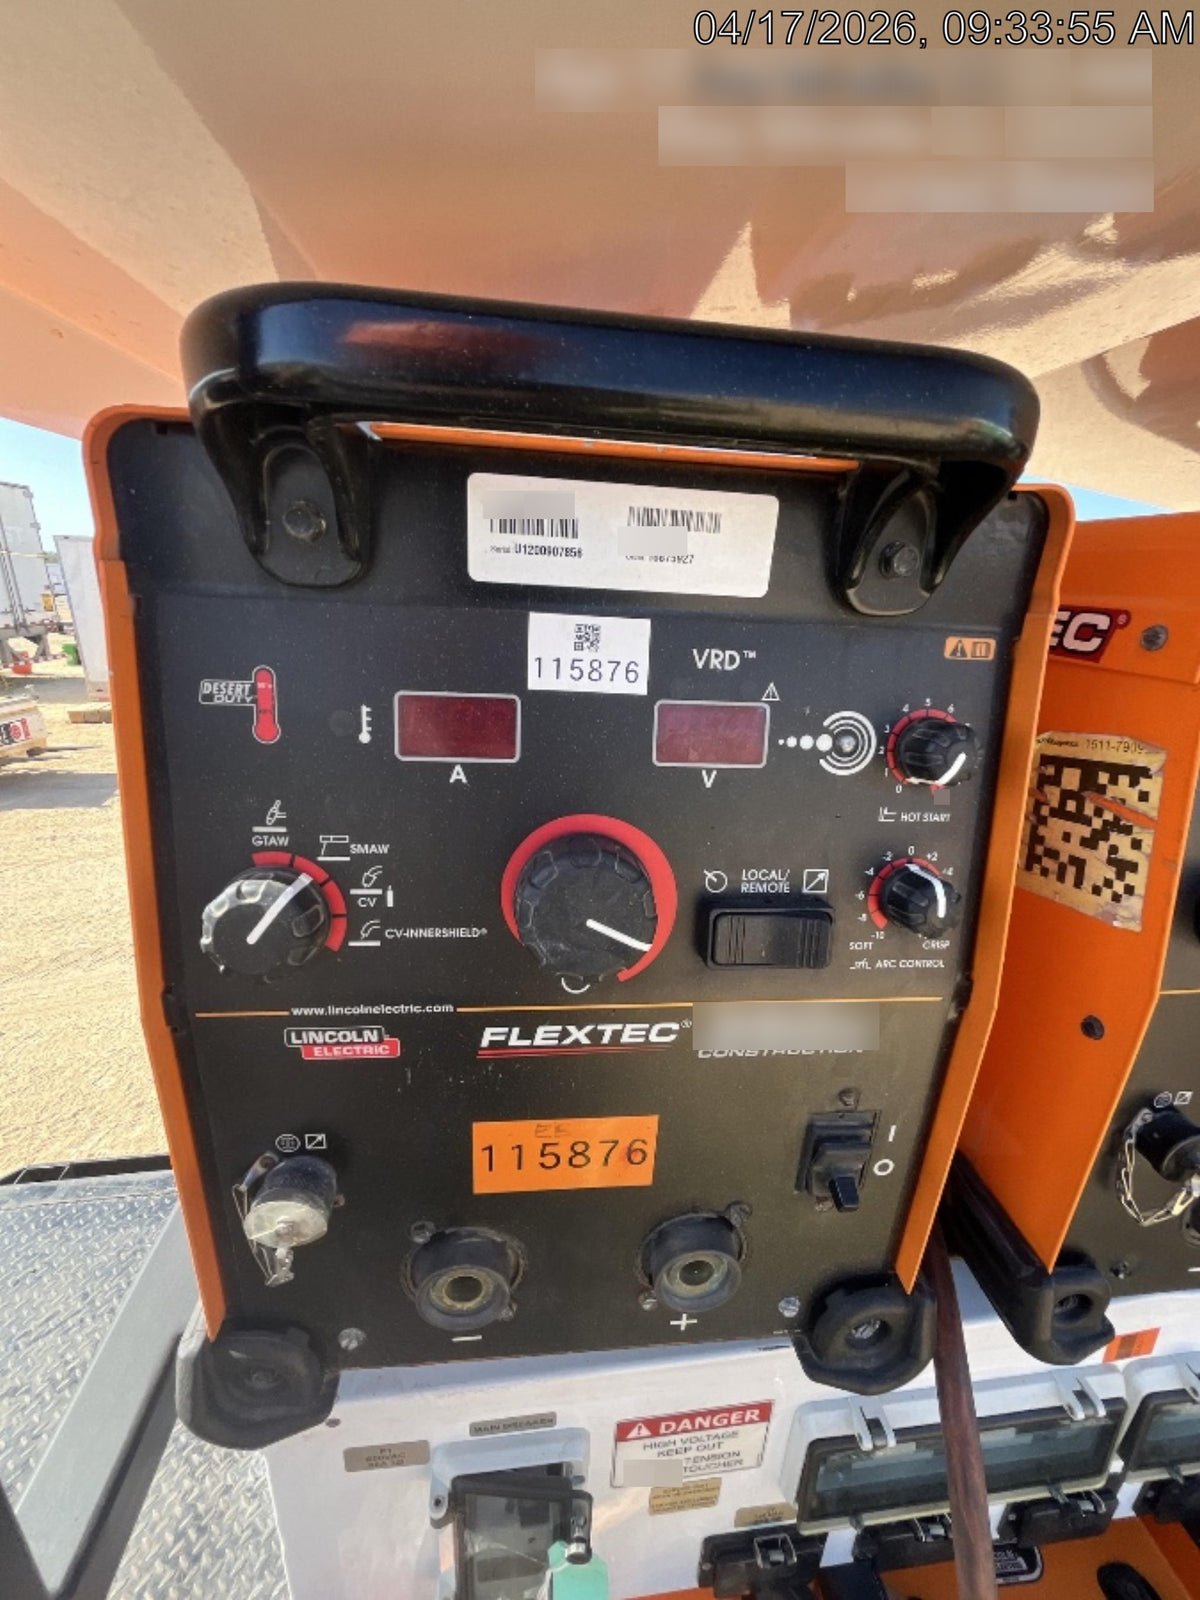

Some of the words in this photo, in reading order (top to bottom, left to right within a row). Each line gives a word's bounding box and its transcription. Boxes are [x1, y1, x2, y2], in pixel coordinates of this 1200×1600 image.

[534, 656, 640, 684] 115876
[202, 682, 252, 697] DESERT
[213, 694, 254, 703] DUTY
[449, 764, 468, 784] A
[701, 769, 717, 788] V
[900, 812, 920, 822] HOT
[922, 812, 951, 822] START
[252, 835, 289, 847] GTAW
[350, 843, 390, 854] SMAW
[907, 845, 915, 855] 0
[741, 868, 791, 881] LOCAL/
[740, 881, 791, 893] REMOTE
[358, 896, 376, 908] CV
[848, 941, 874, 951] SOFT
[922, 940, 951, 950] CRISP
[875, 959, 897, 968] ARC
[898, 959, 945, 968] CONTROL
[290, 1003, 455, 1016] www.lincolnelectric.com
[290, 1029, 380, 1044] LINCOLN
[313, 1044, 390, 1057] ELECTRIC
[481, 1138, 649, 1173] 115876
[659, 1409, 761, 1435] DANGER
[642, 1438, 677, 1451] HIGH
[680, 1430, 740, 1446] VOLTAGE
[656, 1446, 693, 1458] KEEP
[696, 1441, 725, 1452] OUT
[684, 1450, 741, 1465] TENSION
[682, 1458, 745, 1473] TOUCHER
